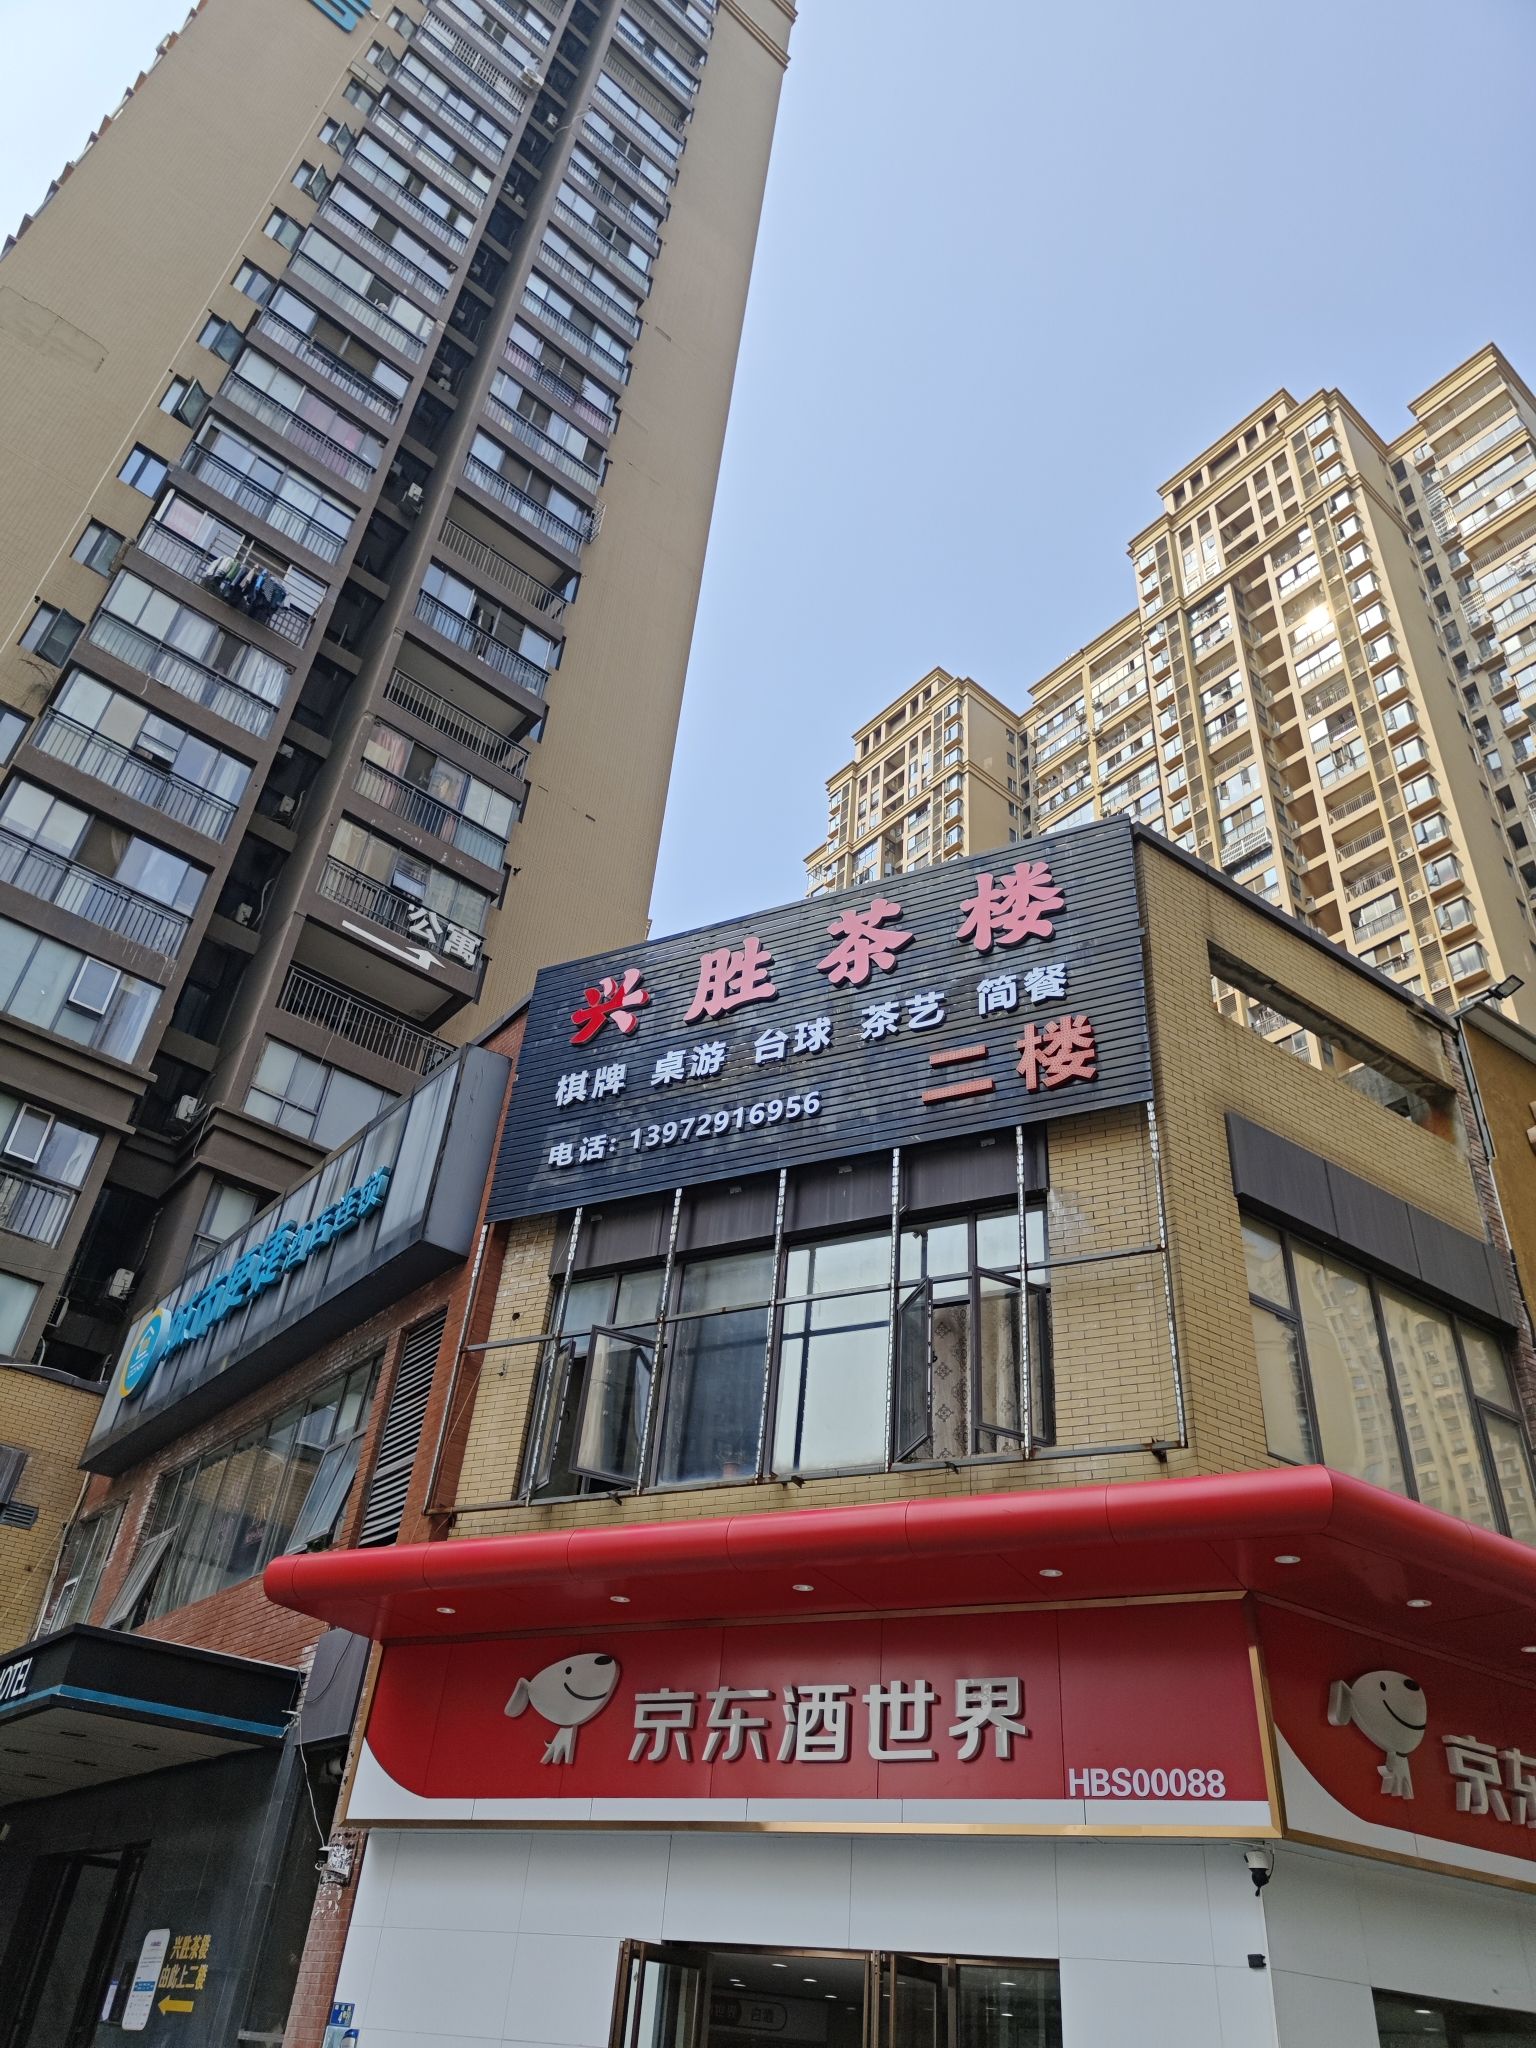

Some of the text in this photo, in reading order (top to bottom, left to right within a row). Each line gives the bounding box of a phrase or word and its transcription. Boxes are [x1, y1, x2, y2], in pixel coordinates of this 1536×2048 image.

[407, 905, 482, 966] 公寓
[569, 861, 1066, 1046] 兴胜茶楼
[554, 963, 1069, 1107] 棋牌 桌游 台球 茶艺 简餐
[921, 1014, 1098, 1104] 二楼
[628, 1676, 1027, 1763] 京东酒世界
[1068, 1767, 1226, 1798] HBS00088
